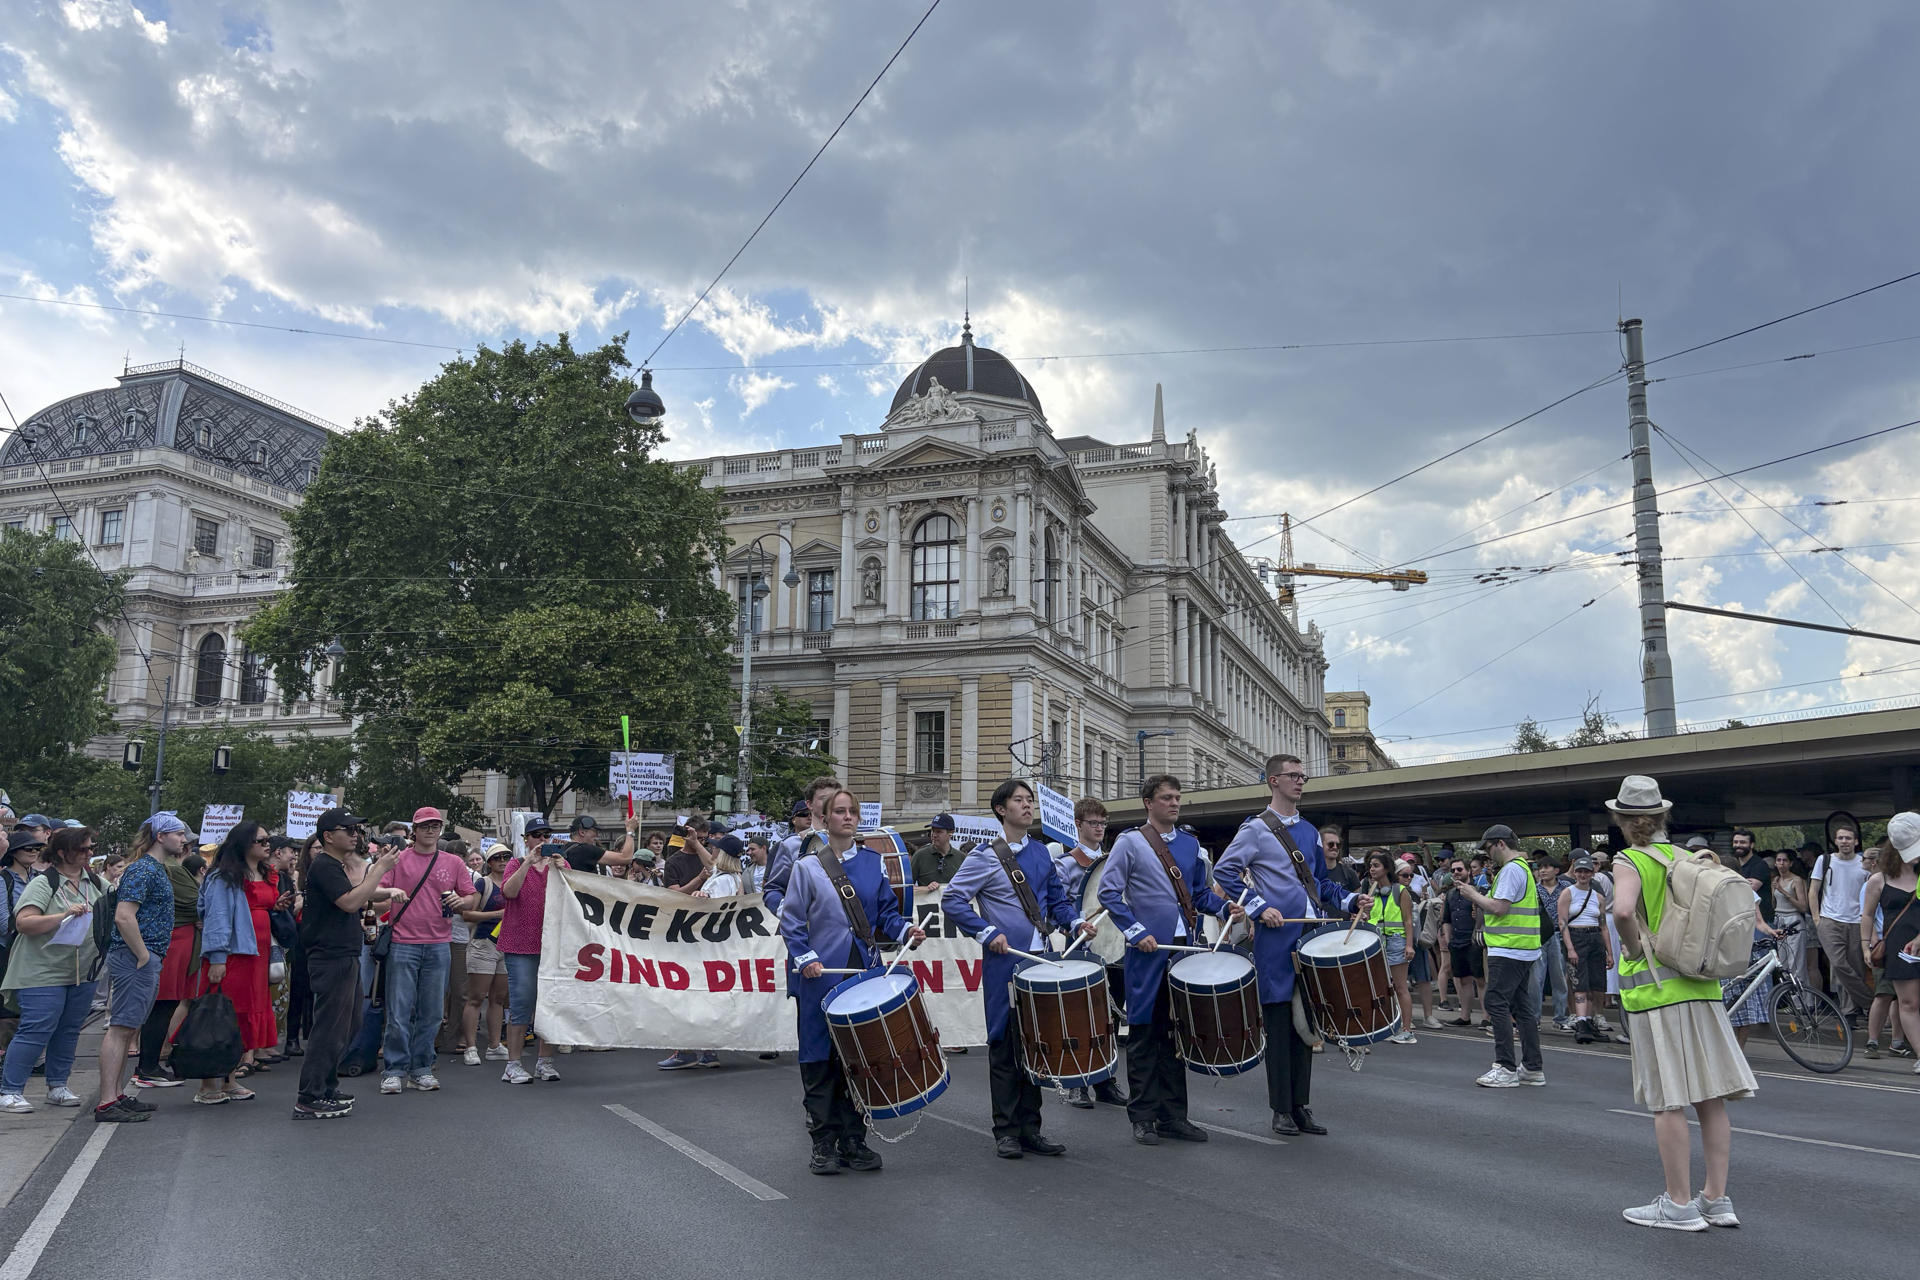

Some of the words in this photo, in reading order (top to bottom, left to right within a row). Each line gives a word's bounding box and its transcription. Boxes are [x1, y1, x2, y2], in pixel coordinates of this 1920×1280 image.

[613, 772, 672, 781] Muskausbildung
[1040, 785, 1073, 811] Kulturnation
[1043, 809, 1076, 837] Nulltarif!
[574, 890, 660, 940] DIE
[666, 901, 782, 944] KÜR
[574, 943, 690, 991] SIND
[703, 958, 776, 993] DIE
